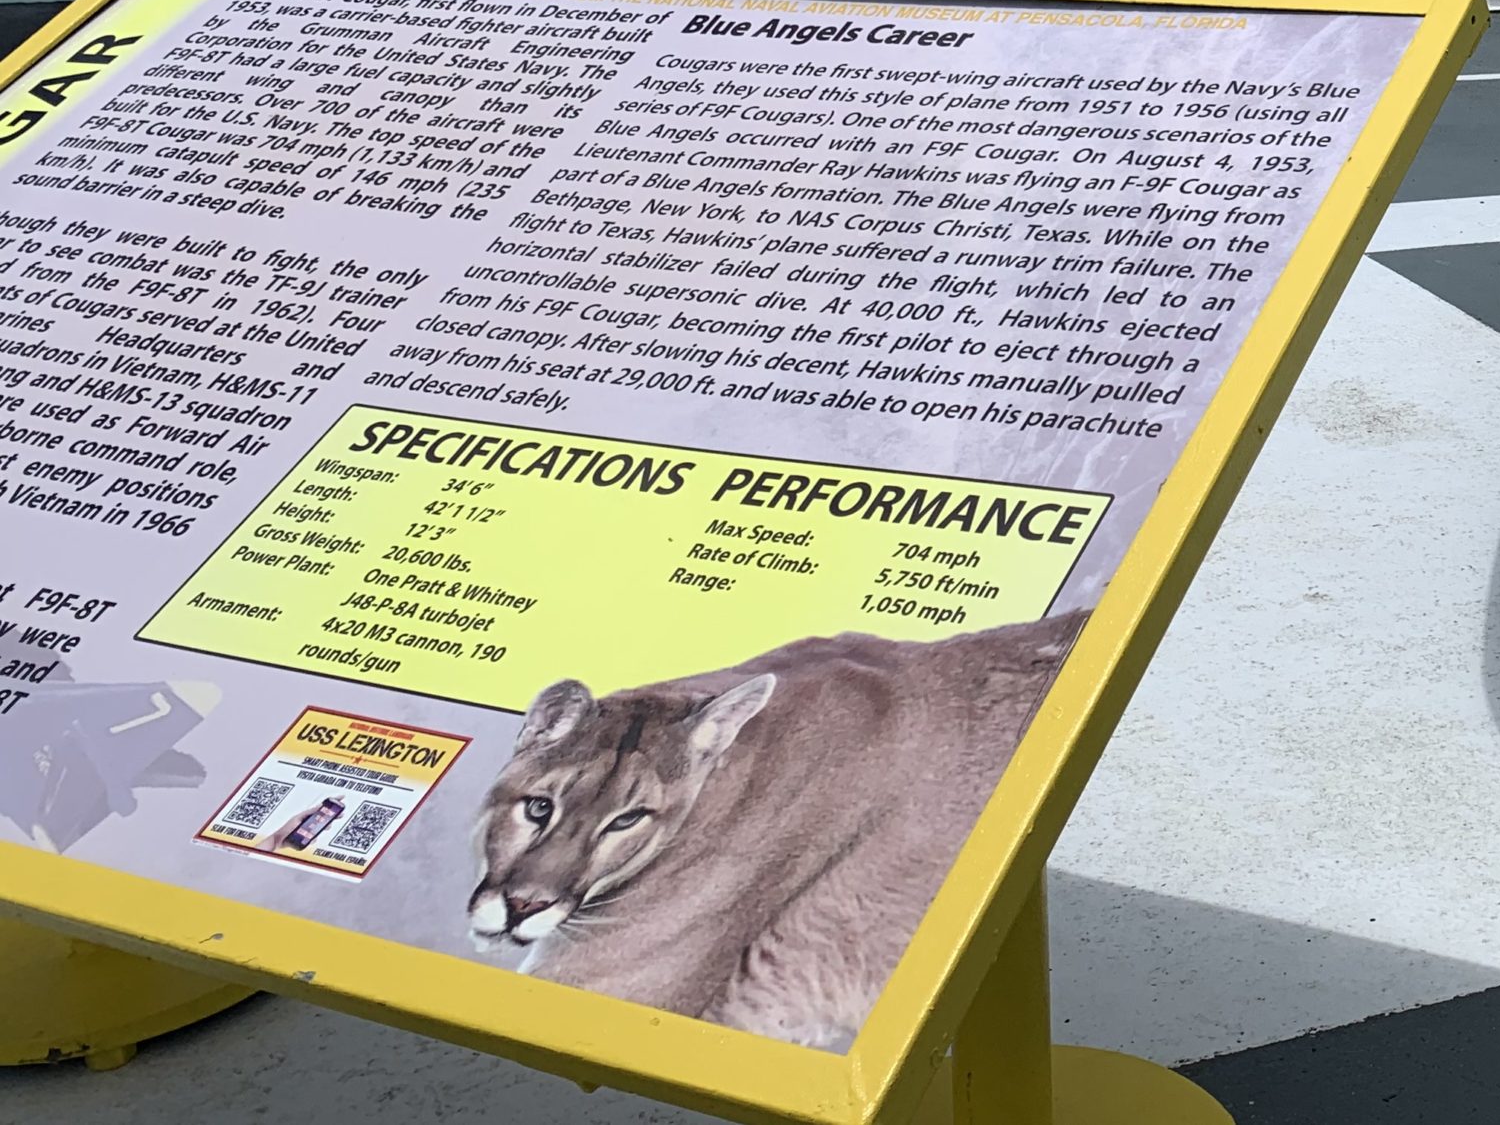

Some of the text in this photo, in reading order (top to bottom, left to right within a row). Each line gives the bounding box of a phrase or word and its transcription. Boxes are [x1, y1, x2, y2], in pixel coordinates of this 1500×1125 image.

[513, 2, 537, 17] in
[538, 4, 644, 24] December
[644, 11, 675, 25] of
[681, 14, 975, 48] Blue Angels Career
[804, 2, 893, 15] AVIATION
[895, 6, 985, 20] MUSEUM
[984, 10, 1015, 21] AT
[1016, 11, 1145, 27] PENSACOLA,
[1154, 15, 1249, 29] FLORIDA
[143, 63, 584, 120] different wing and canopy than its
[593, 119, 1314, 178] Blue Angels occurred with an F9F Cougar. On August 4, 1953,
[34, 150, 489, 222] km/h). It was also capable of breaking the
[530, 188, 1270, 254] Bethpage, New York, to NAS Corpus Christi, Texas. While on the
[464, 265, 1223, 342] uncontrollable supersonic dive. At 40,000 ft., Hawkins ejected
[81, 349, 110, 371] in
[109, 354, 203, 390] Vietnam,
[206, 371, 318, 405] H&MS-11
[95, 325, 247, 366] Headquarters
[291, 362, 346, 381] and
[415, 314, 1187, 405] closed canopy. After slowing his decent, Hawkins manually pulled
[363, 370, 571, 414] and descend safely.
[314, 458, 400, 483] Wingspan:
[350, 422, 694, 494] SPECIFICATIONS
[8, 483, 197, 537] Vietnam in 1966
[272, 500, 336, 524] Height:
[292, 479, 358, 502] Length:
[714, 469, 1089, 544] PERFORMANCE
[253, 523, 472, 573] Gross Weight: 20,600 lbs.
[686, 543, 1000, 600] Rate of Climb: 5,750 ft/min
[704, 519, 981, 570] Max Speed: 704 mph
[230, 545, 538, 614] Power Plant: One Pratt & Whitney
[668, 567, 967, 626] Range: 1,050 mph
[186, 591, 507, 663] Armament: 4x20 M3 cannon, 190
[339, 591, 495, 633] J48-P-8A turbojet
[297, 644, 401, 673] rounds/gun
[296, 722, 340, 746] USS
[334, 731, 446, 768] LEXINGTON
